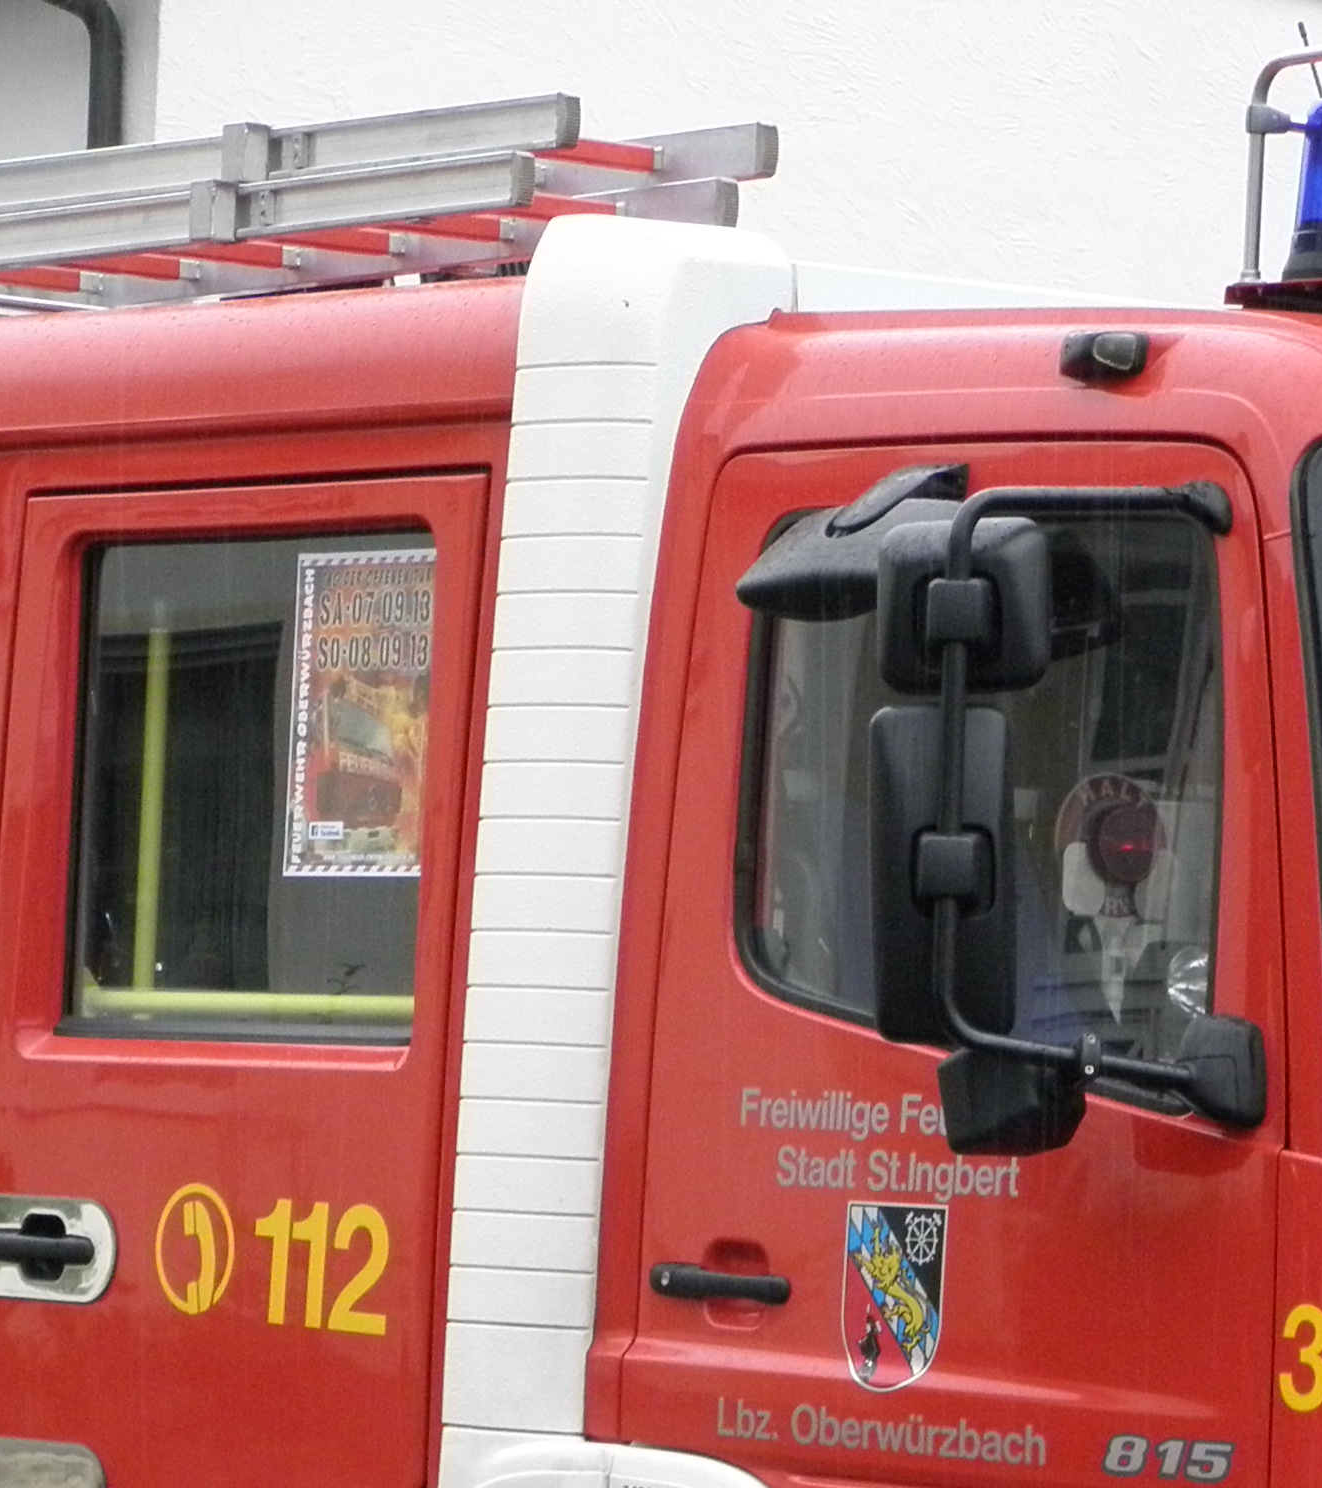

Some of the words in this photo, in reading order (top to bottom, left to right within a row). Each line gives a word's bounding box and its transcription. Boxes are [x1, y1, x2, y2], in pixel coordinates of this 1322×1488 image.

[740, 1087, 890, 1142] Freiwillige
[777, 1145, 856, 1189] Stadt
[867, 1150, 1021, 1203] St.Ingbert
[255, 1198, 390, 1336] 112
[716, 1397, 779, 1442] Lbz.
[790, 1404, 1047, 1467] Oberwürzbach
[1102, 1432, 1235, 1484] 815
